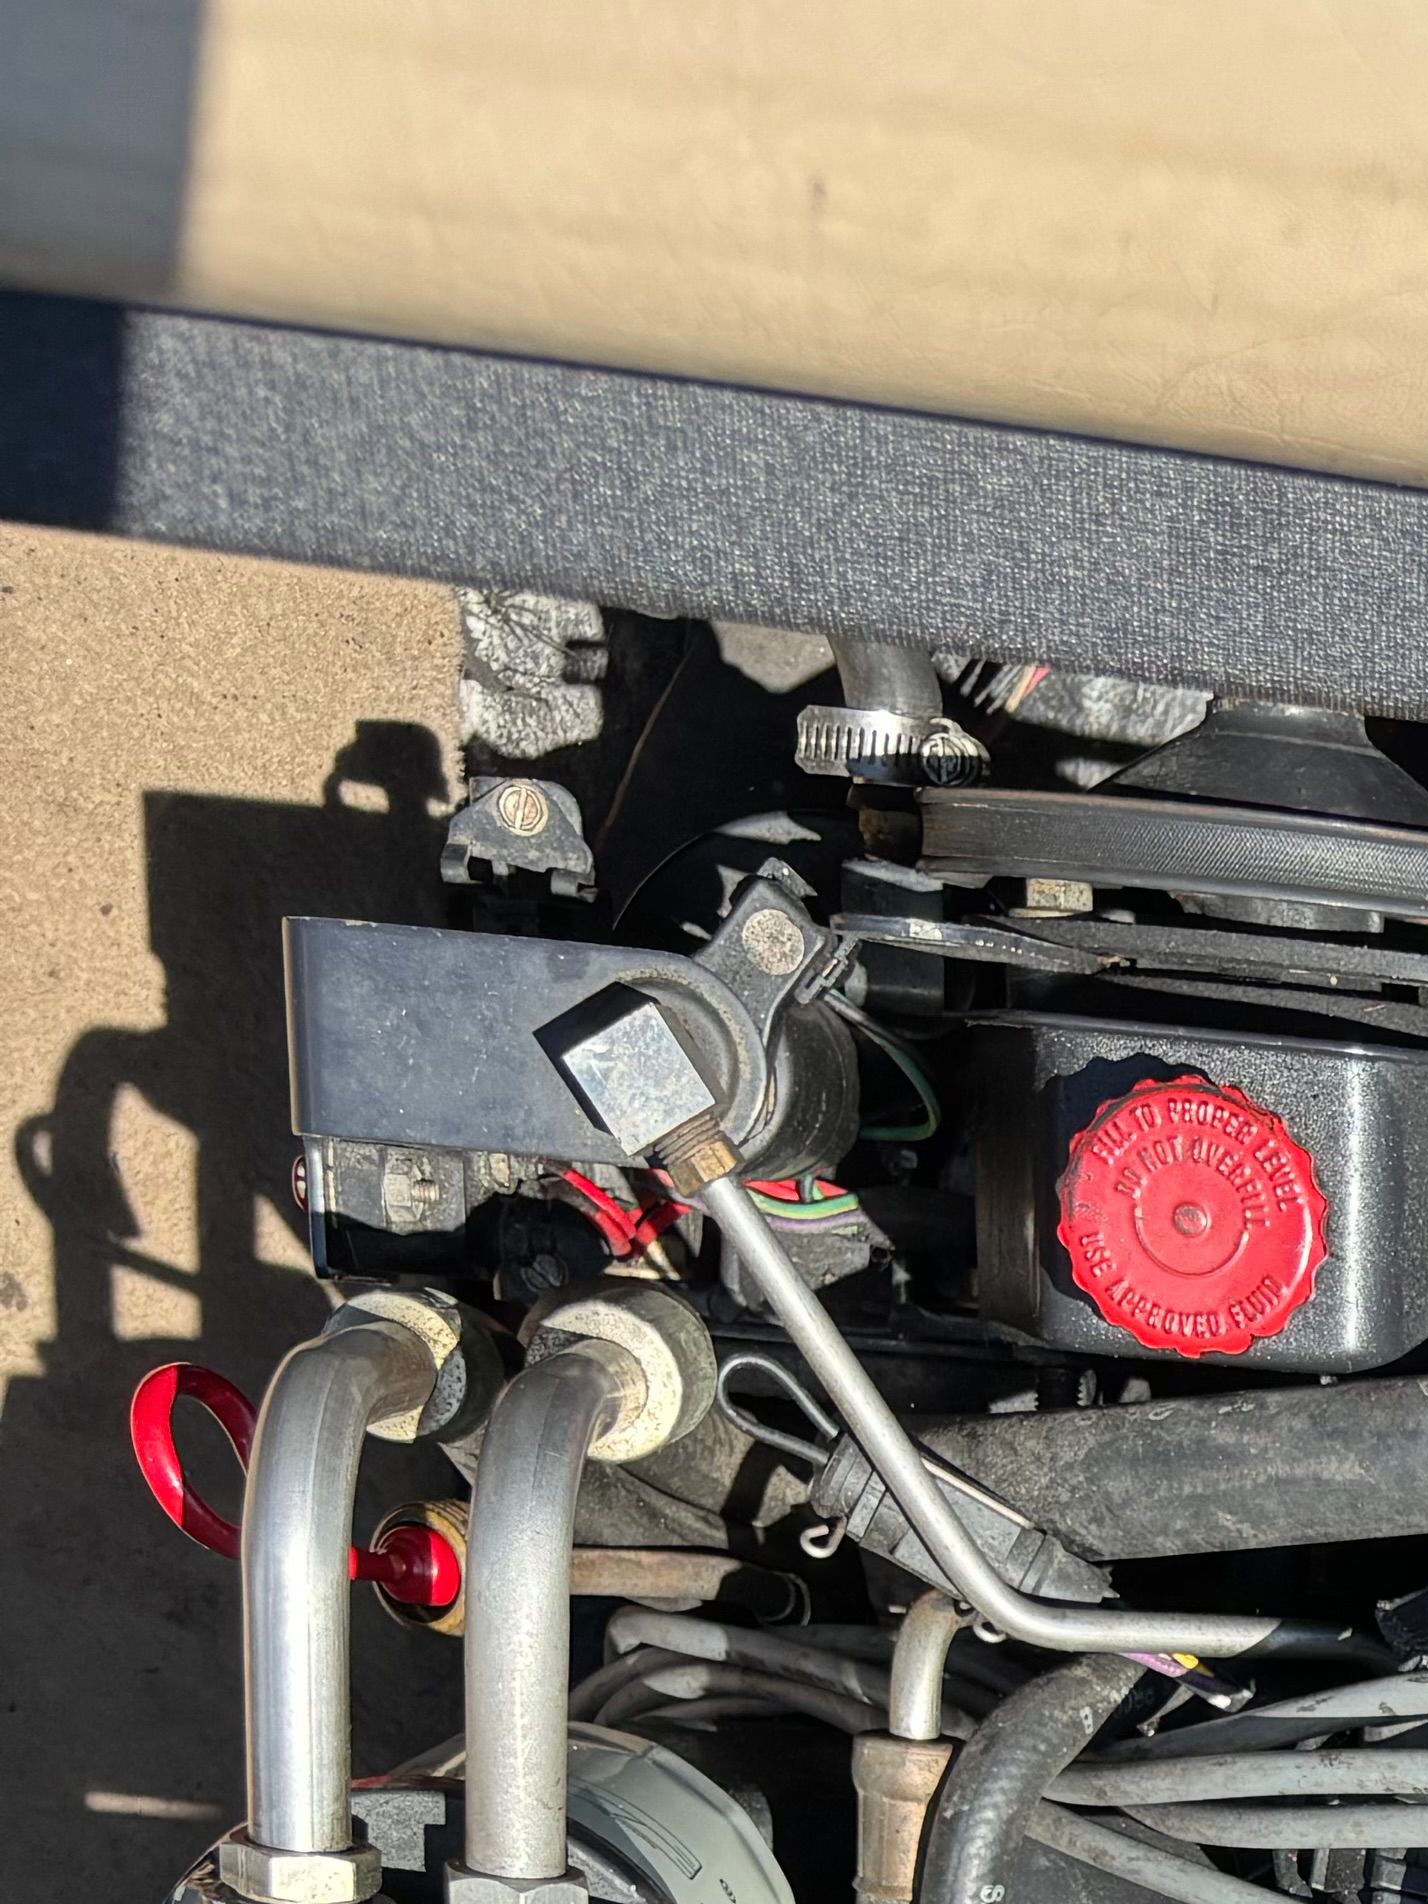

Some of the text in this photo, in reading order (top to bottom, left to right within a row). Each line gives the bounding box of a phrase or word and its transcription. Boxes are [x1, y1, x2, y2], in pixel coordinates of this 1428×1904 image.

[1093, 1097, 1306, 1211] FILL TO PROPER LEVEL
[1137, 1135, 1184, 1172] NOT
[1193, 1136, 1272, 1228] OVERFILL
[1079, 1231, 1291, 1339] USE APPROVED FLUID
